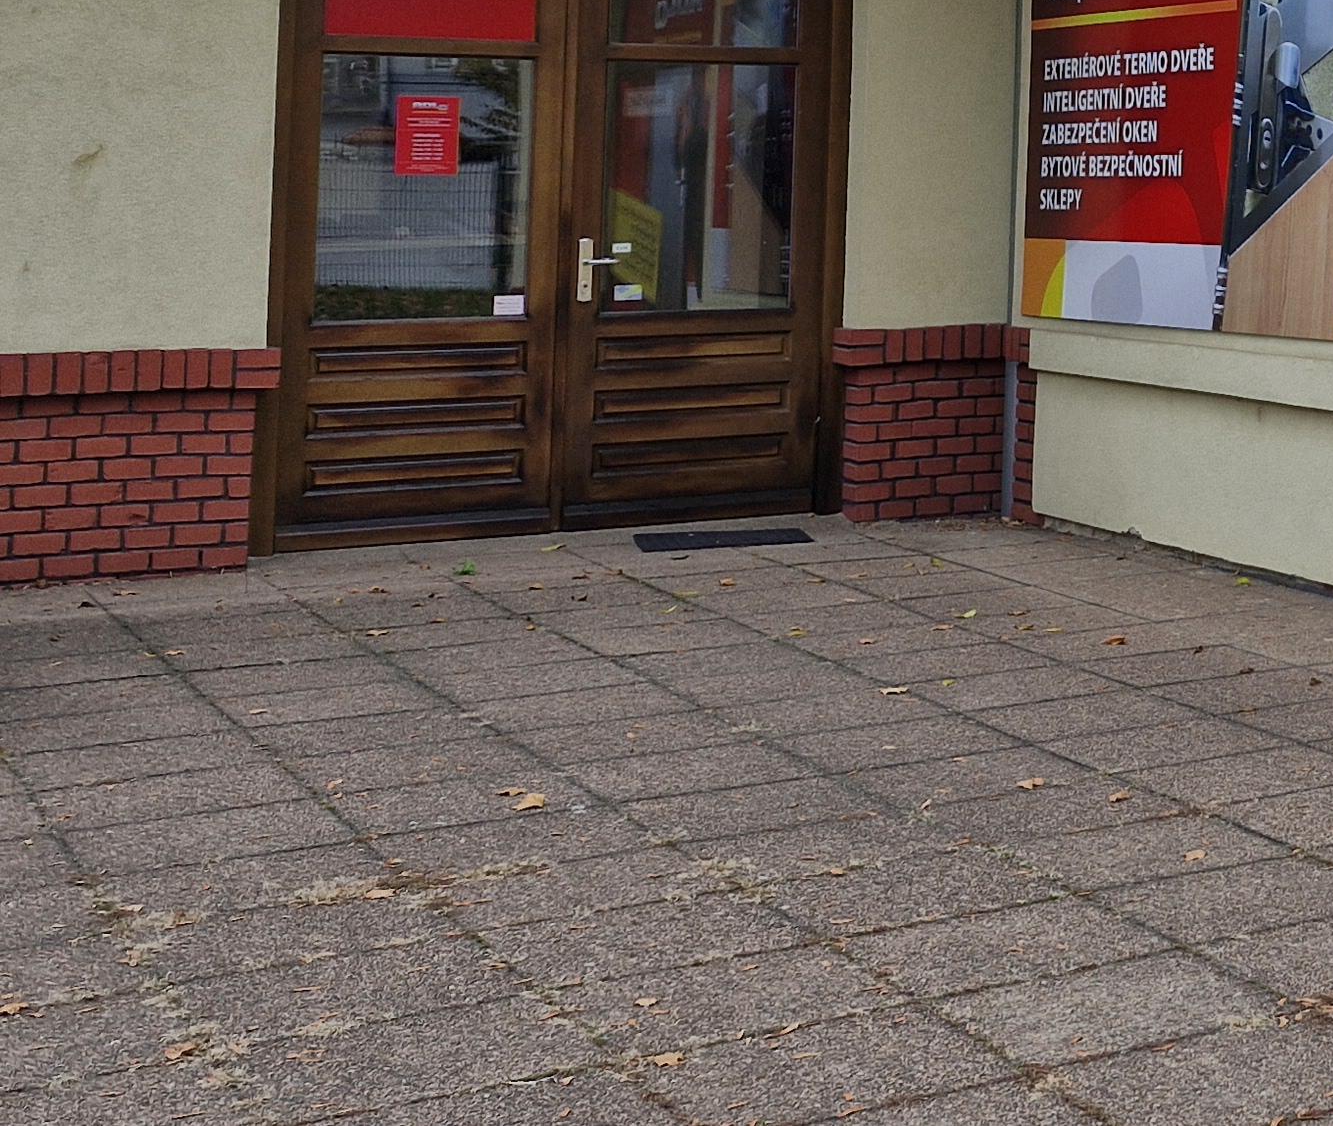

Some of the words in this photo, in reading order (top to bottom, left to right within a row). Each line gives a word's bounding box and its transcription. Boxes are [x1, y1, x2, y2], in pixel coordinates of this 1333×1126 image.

[1043, 50, 1121, 81] EXTERIÉROVÉ
[1123, 51, 1168, 75] TERMO
[1170, 42, 1215, 73] DVEŘE
[1042, 83, 1124, 113] INTELIGENTNÍ
[1125, 81, 1167, 110] DVEŘE
[1041, 117, 1121, 145] ZABEZPEČENÍ
[1122, 120, 1158, 143] OKEN
[1040, 151, 1087, 178] BYTOVÉ
[1088, 150, 1184, 178] BEZPEČNOSTNÍ
[1039, 188, 1083, 211] SKLEPY
